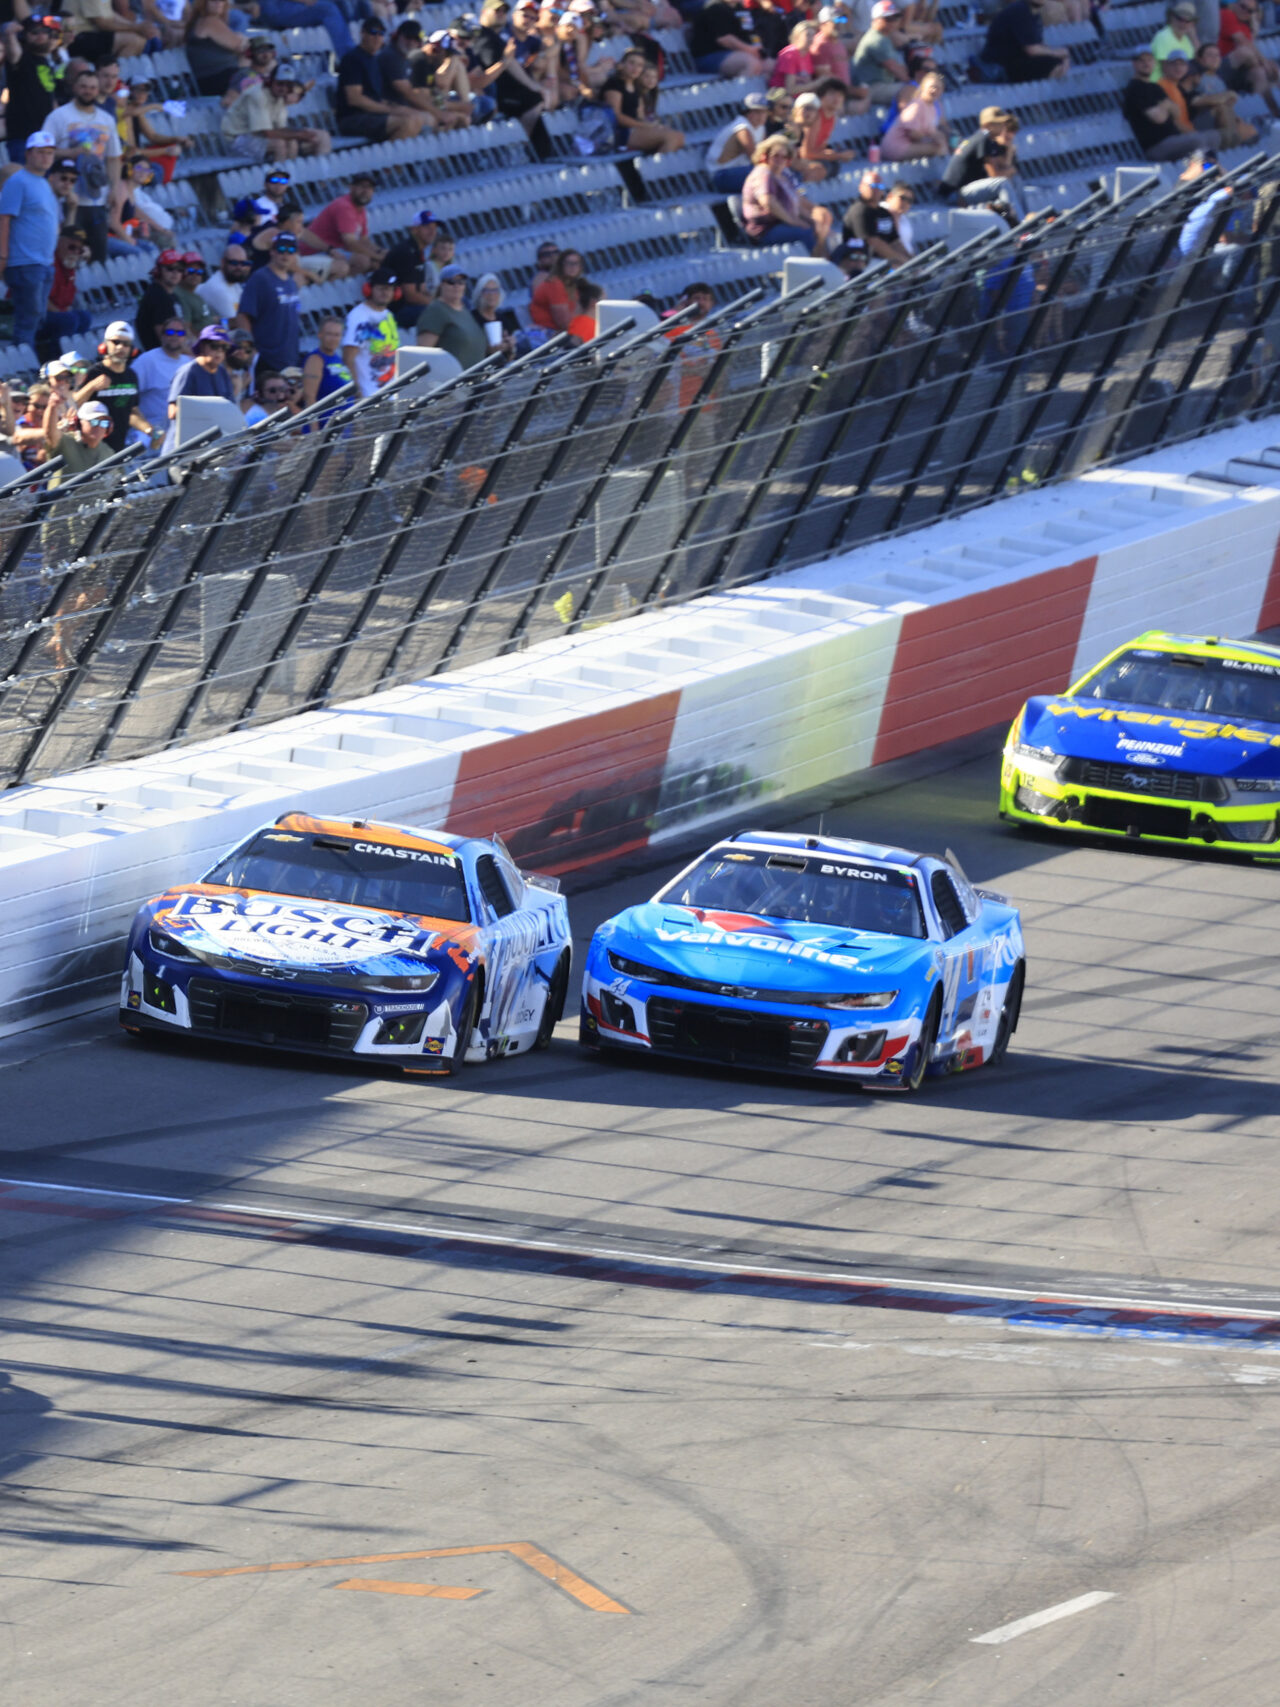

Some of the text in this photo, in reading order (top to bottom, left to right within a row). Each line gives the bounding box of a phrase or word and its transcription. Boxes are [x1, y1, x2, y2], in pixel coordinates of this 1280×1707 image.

[1116, 738, 1183, 757] PENNZOIL
[354, 843, 457, 868] CHASTAIN
[821, 864, 888, 882] BYRON
[176, 895, 440, 951] BUSCH
[220, 920, 370, 950] LIGHT
[654, 927, 860, 969] Valvoline
[156, 964, 166, 979] 1
